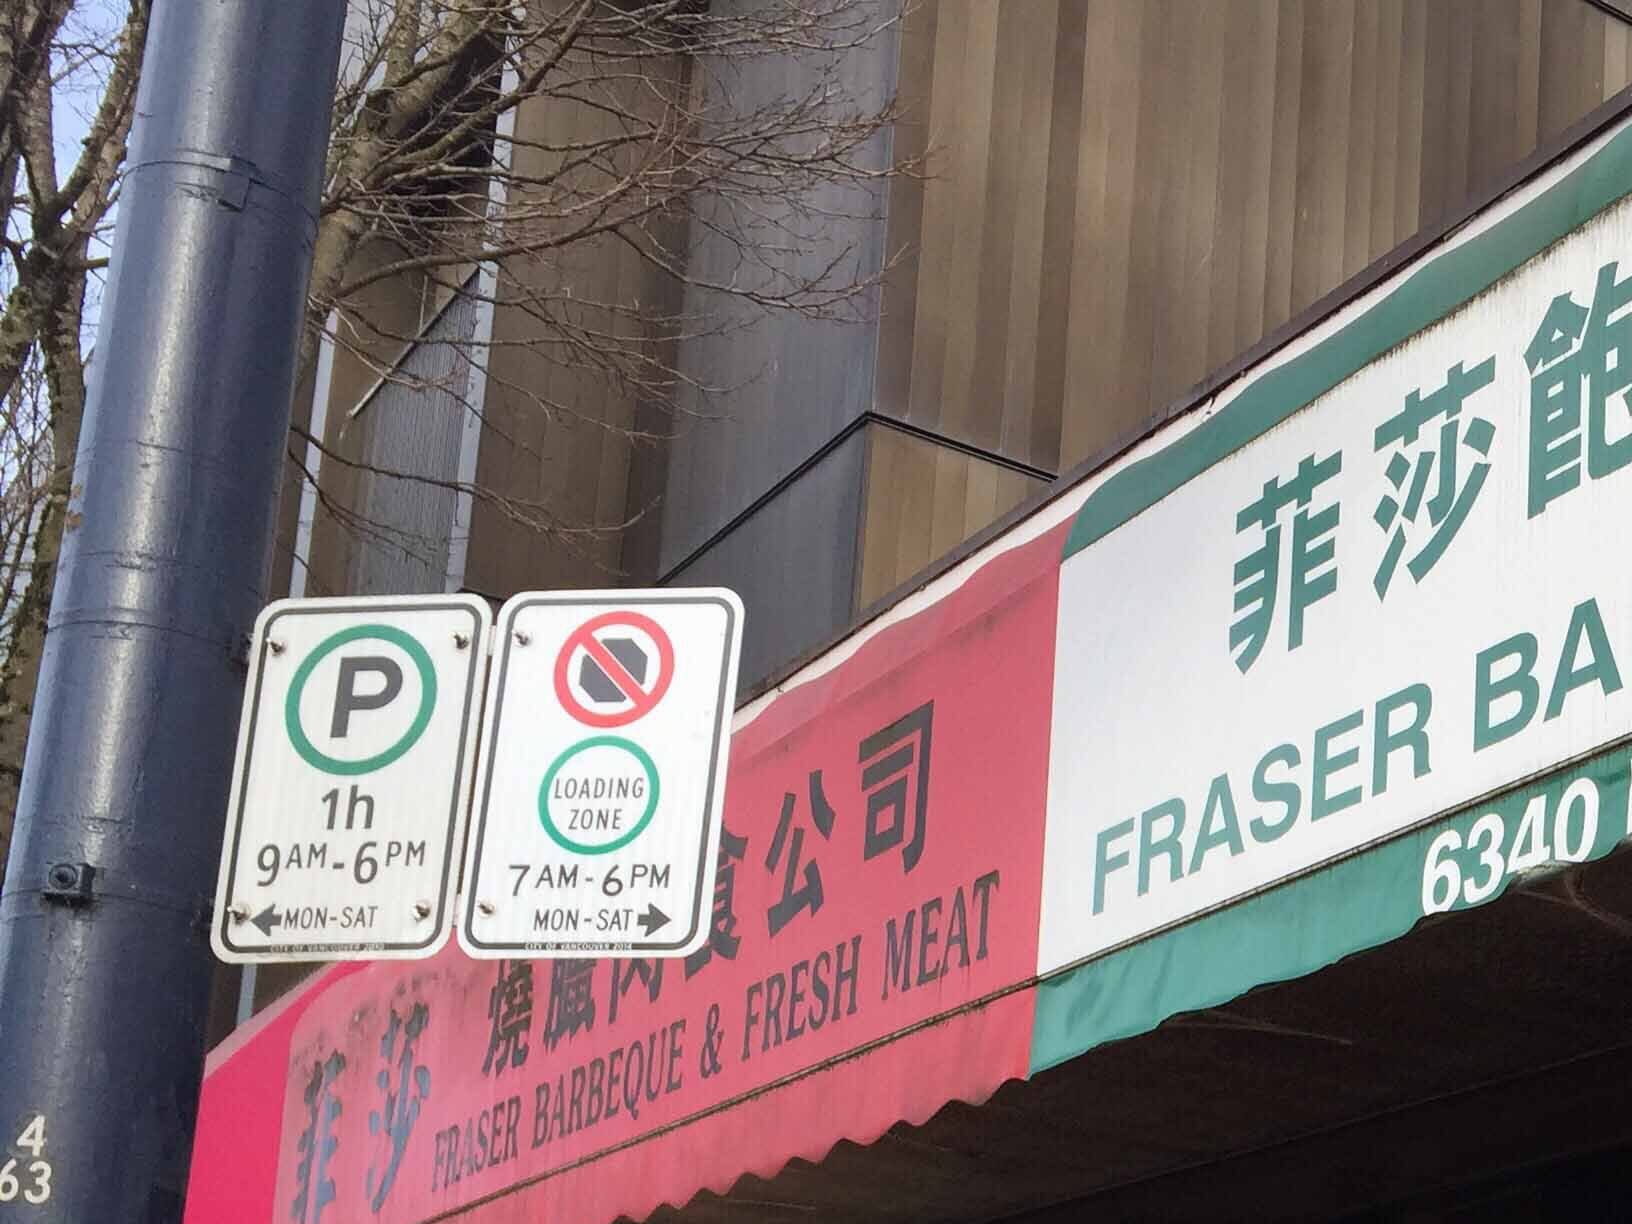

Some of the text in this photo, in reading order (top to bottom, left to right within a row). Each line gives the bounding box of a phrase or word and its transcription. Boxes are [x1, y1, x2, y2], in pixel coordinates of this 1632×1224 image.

[329, 655, 403, 739] P
[321, 785, 375, 831] 1h
[554, 777, 645, 799] LOADING
[1092, 683, 1432, 916] FRASER
[568, 808, 623, 830] ZONE
[1422, 778, 1600, 915] 6340
[284, 905, 379, 930] MON-SAT
[432, 869, 1000, 1192] FRASER BARBEQUE & FRESH MEAT
[16, 1115, 45, 1156] 4
